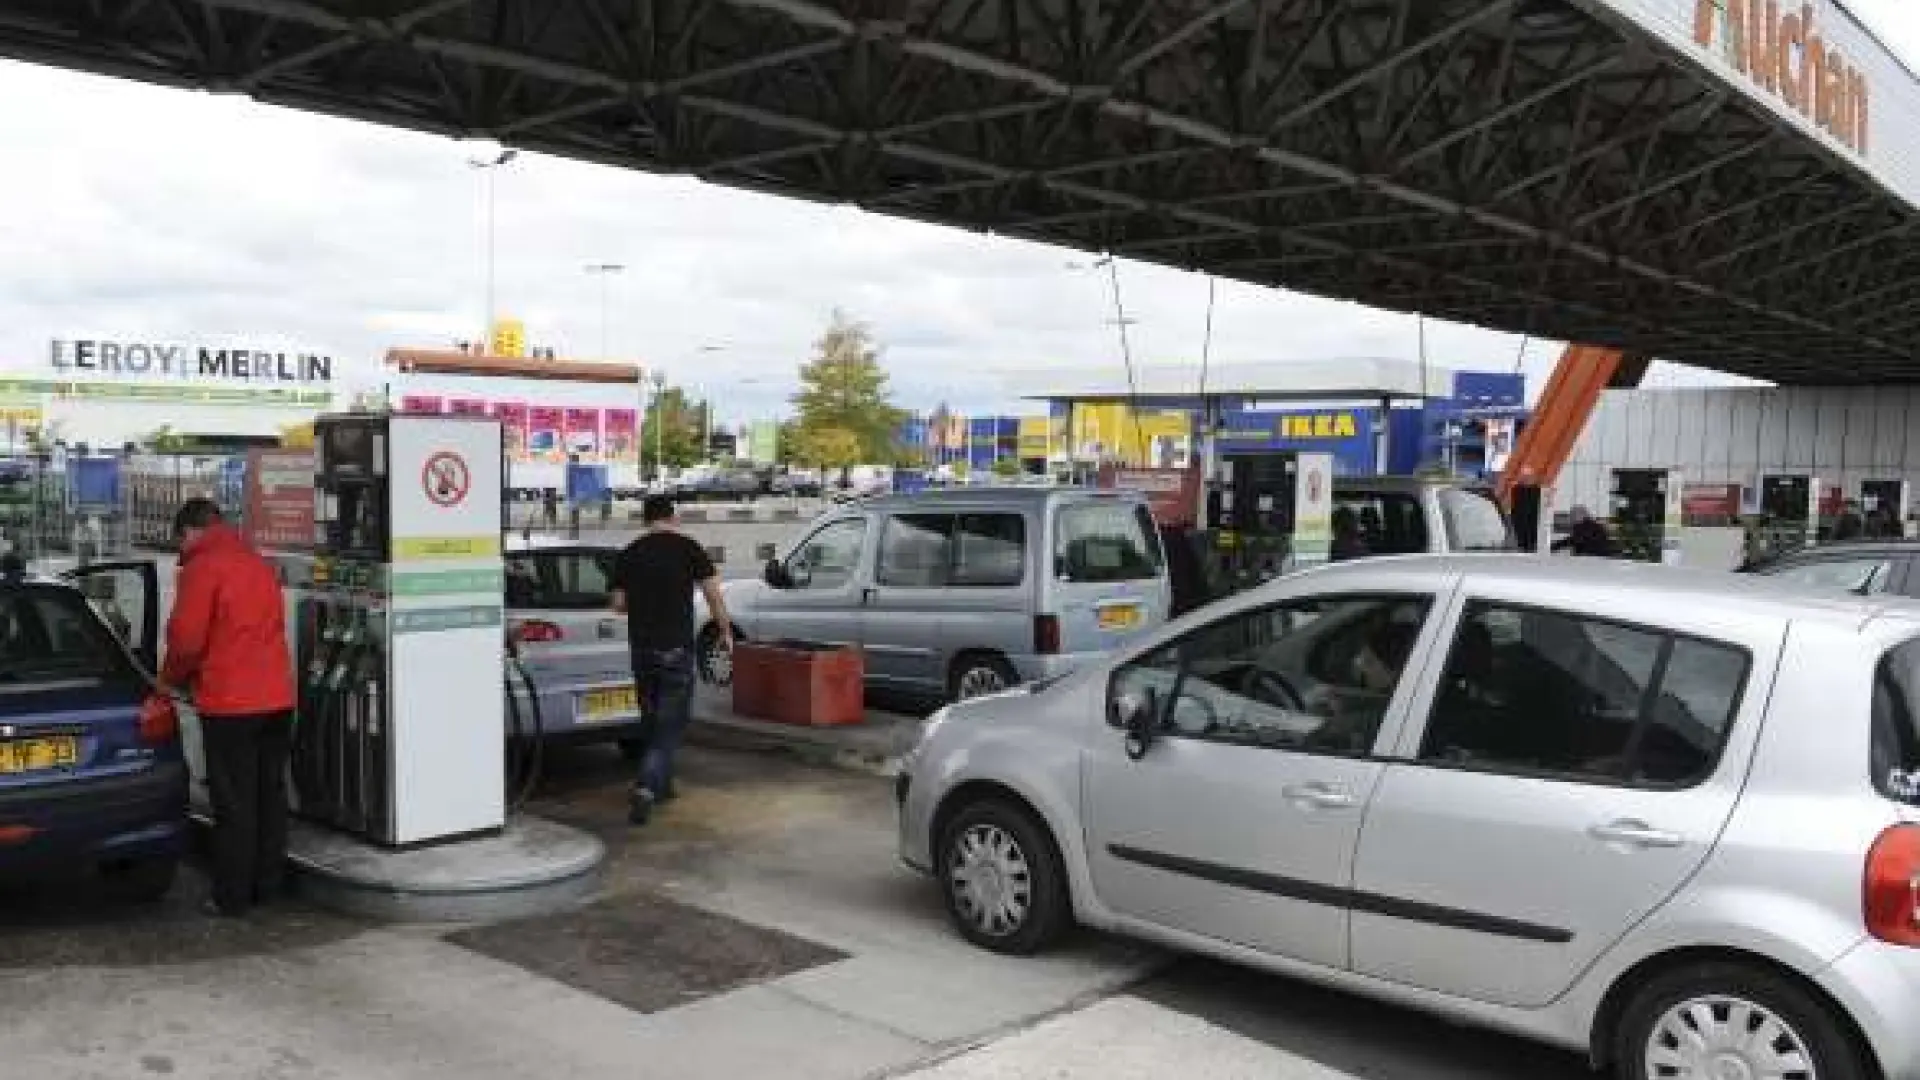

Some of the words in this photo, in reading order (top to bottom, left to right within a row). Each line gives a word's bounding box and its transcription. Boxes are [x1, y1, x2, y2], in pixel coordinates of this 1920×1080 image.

[50, 339, 179, 374] LEROY
[198, 346, 332, 381] MERLIN
[1280, 414, 1356, 437] IKEA
